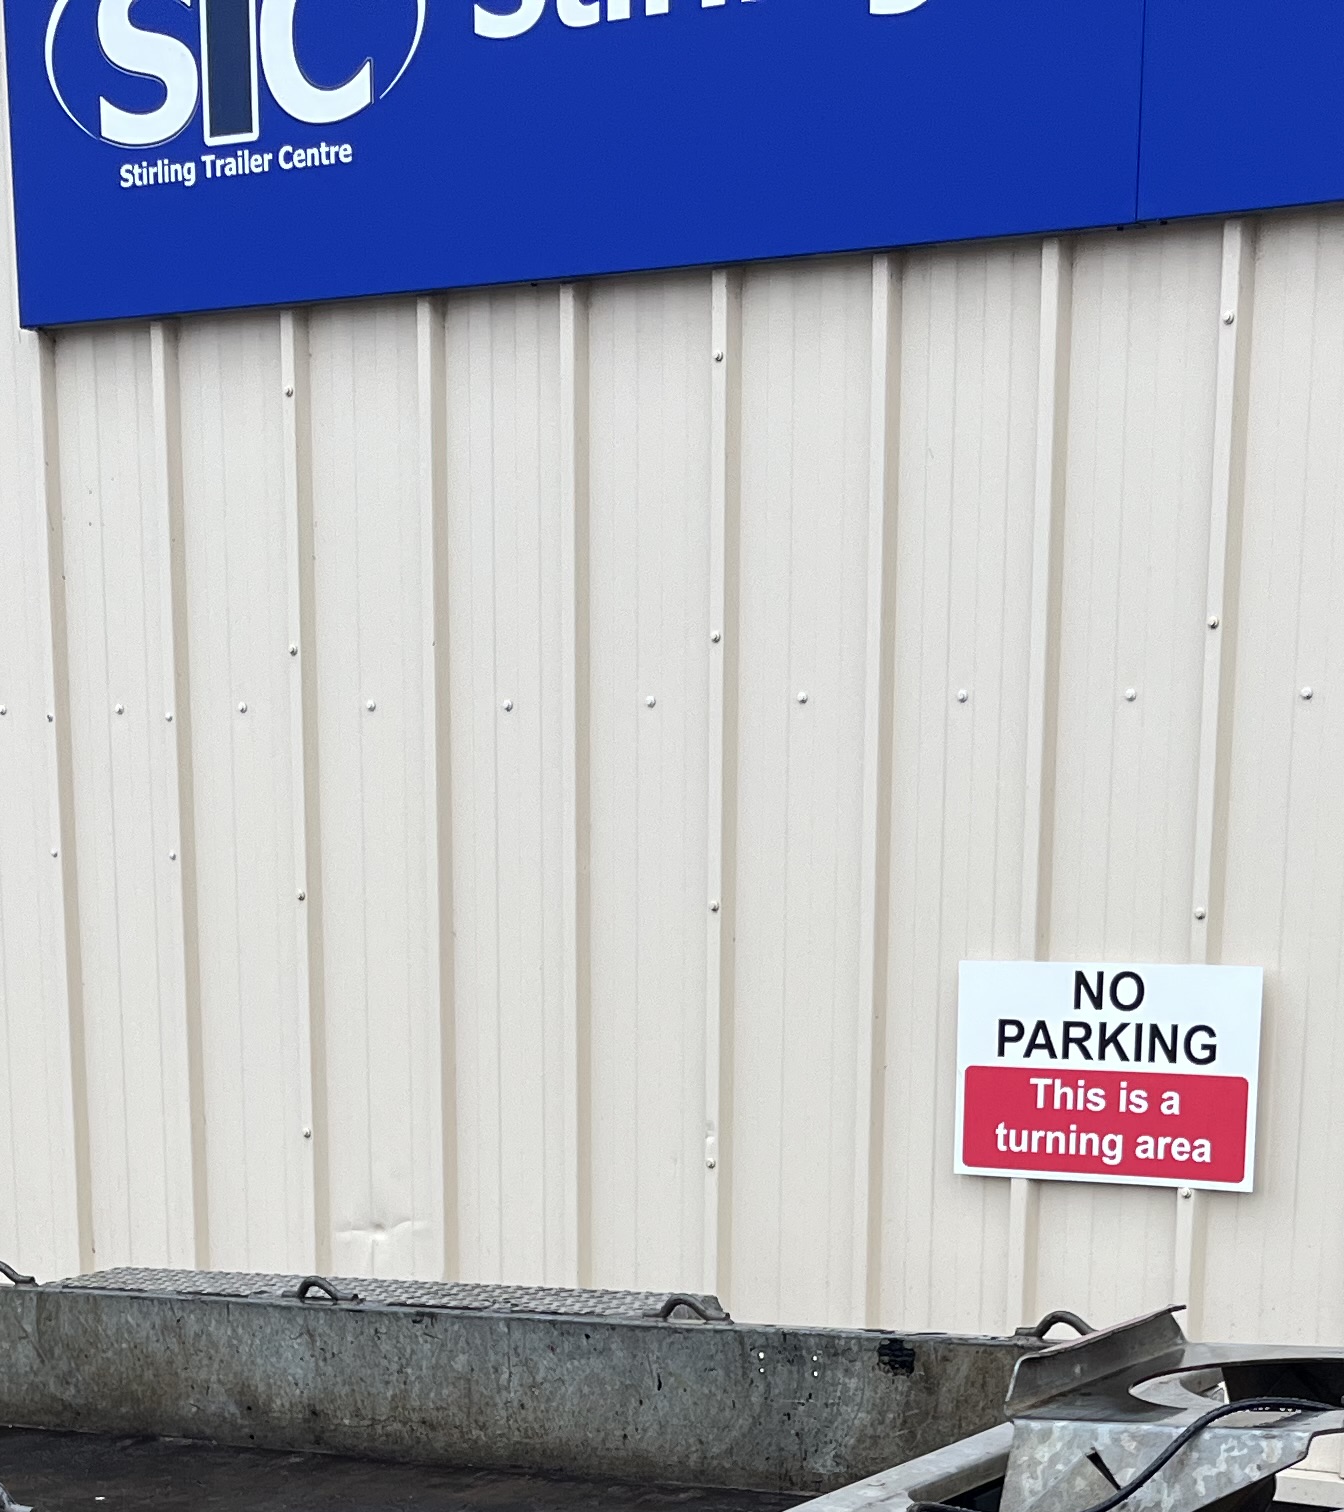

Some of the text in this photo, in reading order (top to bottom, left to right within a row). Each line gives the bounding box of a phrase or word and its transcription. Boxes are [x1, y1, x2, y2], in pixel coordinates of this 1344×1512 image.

[120, 142, 353, 188] Stirling Trailer Centre
[1073, 970, 1145, 1011] NO
[997, 1018, 1218, 1066] PARKING
[1029, 1077, 1180, 1115] This is a
[995, 1122, 1211, 1166] turning area
